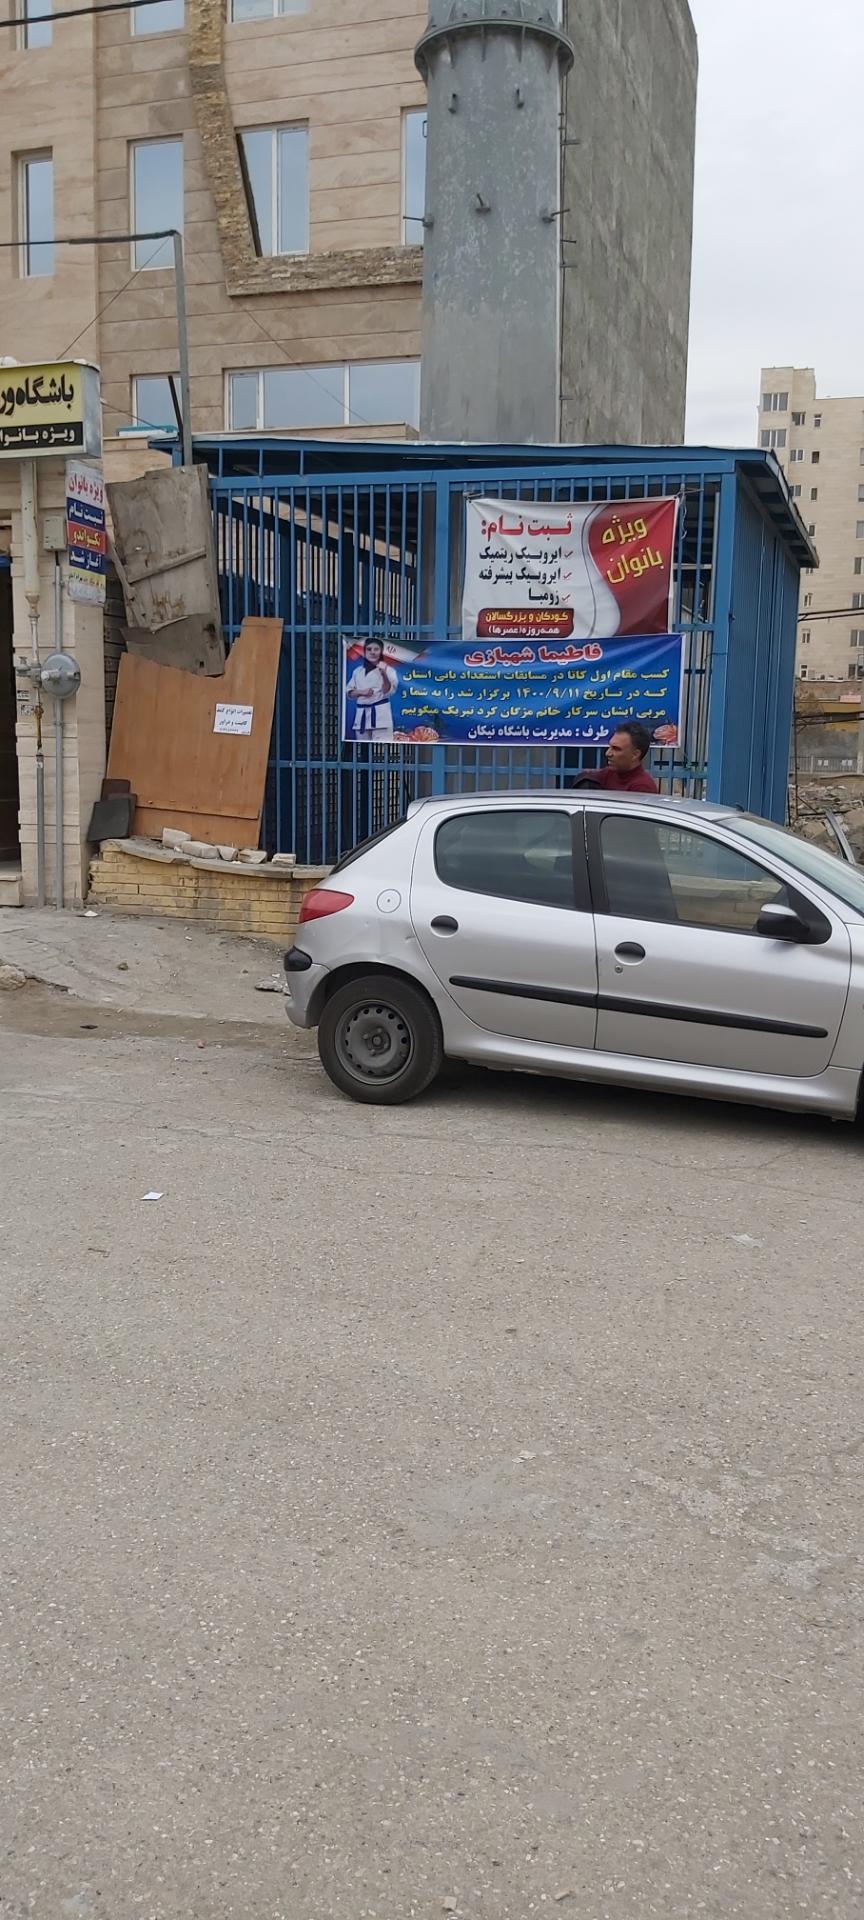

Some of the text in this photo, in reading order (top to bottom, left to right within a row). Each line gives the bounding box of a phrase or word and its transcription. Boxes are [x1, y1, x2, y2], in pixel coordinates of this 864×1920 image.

[16, 373, 75, 410] باشگاه
[42, 426, 75, 444] ویژه
[68, 472, 104, 504] ویژه بانوان
[68, 502, 104, 527] ثبت نام
[481, 513, 573, 542] ثبت نام:
[601, 514, 648, 546] ویژه
[70, 550, 85, 564] شد
[479, 546, 562, 564] ایروبیک ریتمیک
[606, 547, 665, 585] بانوان
[478, 565, 561, 585] ایروبیک پیشرفته
[528, 588, 560, 606] زومبا
[485, 610, 569, 624] کودکان و بزرگسالان
[463, 643, 603, 668] فاطیما شهبازی
[402, 669, 670, 683] کسب مقام اول کاتا در مسابقات استعداد یابی استان
[401, 690, 408, 699] و
[409, 687, 428, 697] شما
[431, 688, 441, 698] به
[444, 688, 455, 700] را
[457, 688, 473, 698] شد
[476, 688, 510, 701] برگزار
[583, 688, 623, 700] تاریخ
[626, 689, 640, 700] در
[643, 687, 667, 697] که
[401, 705, 439, 718] میگوییم
[442, 705, 474, 718] تبریک
[477, 706, 497, 718] کرد
[536, 706, 560, 718] خانم
[601, 706, 633, 719] ایشان
[636, 708, 666, 719] مربی
[467, 724, 495, 739] نیکان
[498, 725, 529, 739] باشگاه
[532, 726, 572, 740] مدیریت
[582, 724, 609, 740] طرف
